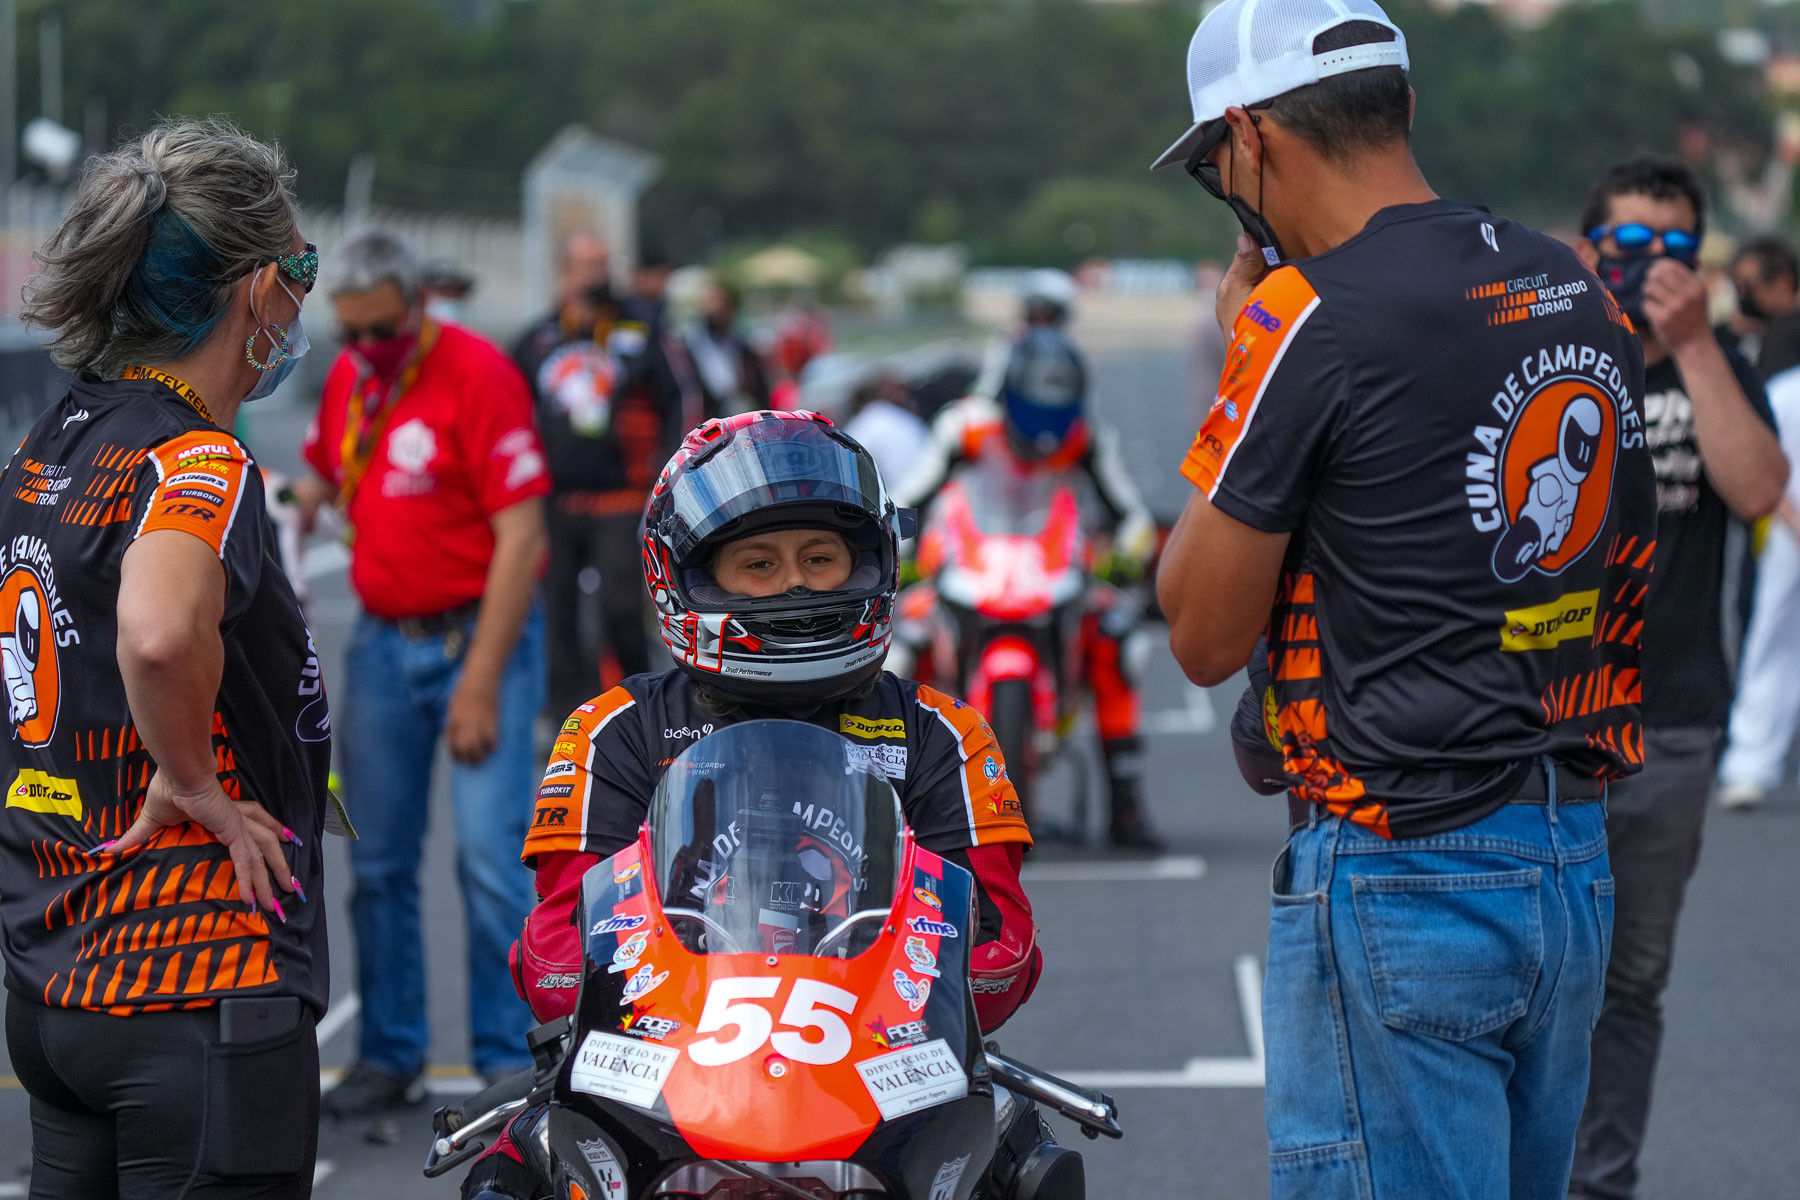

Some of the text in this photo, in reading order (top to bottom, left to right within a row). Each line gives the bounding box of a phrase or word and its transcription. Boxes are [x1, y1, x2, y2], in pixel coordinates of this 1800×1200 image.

[1506, 273, 1550, 293] CIRCUIT
[1537, 280, 1588, 302] RICARDO
[1529, 298, 1573, 318] TORMO
[154, 372, 186, 391] CEV
[1465, 344, 1644, 534] CUNA DE CAMPEONES
[177, 445, 231, 460] MOTUL
[168, 474, 226, 487] RAINERS
[181, 490, 222, 504] TURBOKIT
[1530, 606, 1593, 637] DUOP
[856, 722, 905, 733] DUNLO
[912, 917, 956, 936] rfme
[687, 976, 859, 1067] 55
